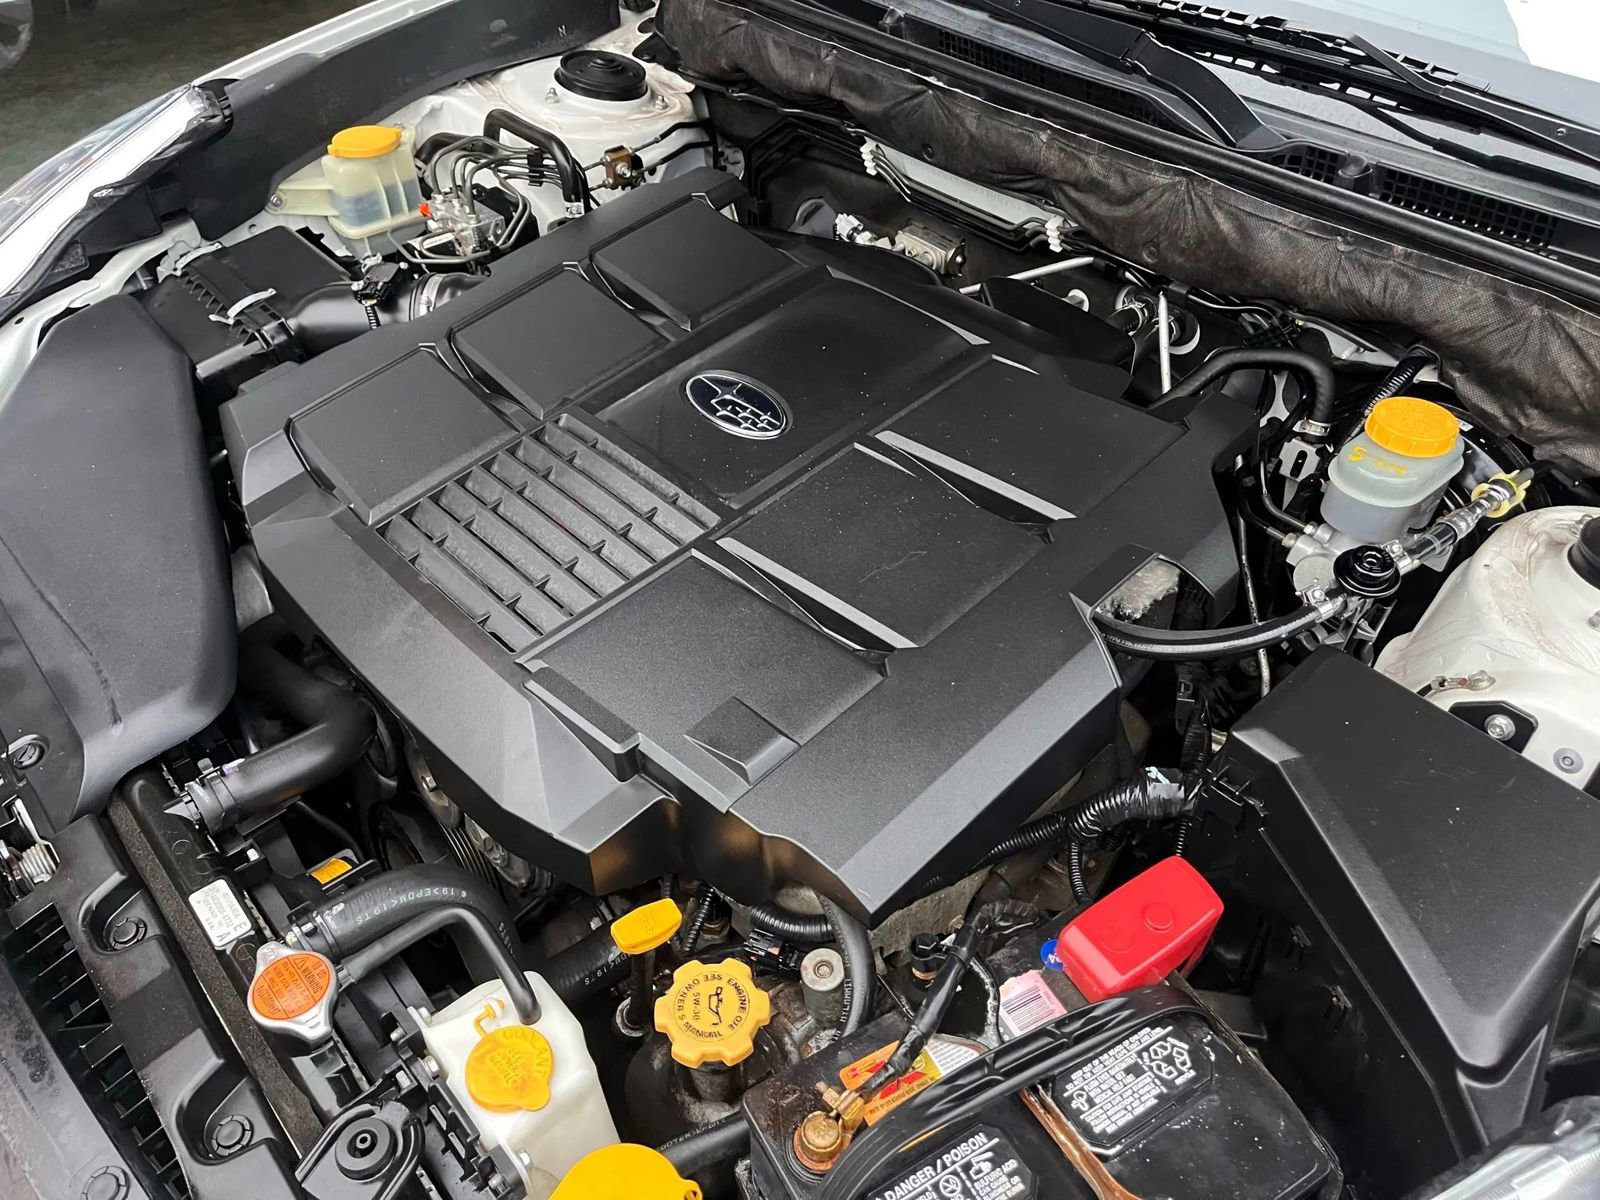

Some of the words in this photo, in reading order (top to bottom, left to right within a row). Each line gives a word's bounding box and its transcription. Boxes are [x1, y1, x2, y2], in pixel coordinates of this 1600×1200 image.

[299, 965, 323, 994] WARNING
[703, 973, 722, 981] SEE
[727, 978, 747, 1014] ENGINE
[728, 1015, 743, 1031] OIL
[1065, 1082, 1074, 1090] DO
[1072, 1076, 1084, 1085] NOT
[1103, 1055, 1116, 1066] VENT
[1114, 1047, 1128, 1059] CAPS
[1082, 1063, 1093, 1073] OUT
[1092, 1058, 1100, 1066] OF
[1098, 1052, 1109, 1062] THE
[1107, 1043, 1124, 1056] REACH
[1122, 1038, 1130, 1046] OF
[884, 1167, 936, 1200] DANGER
[942, 1132, 989, 1166] POISON
[974, 1168, 1003, 1190] SULFURIC
[1001, 1159, 1018, 1173] ACID
[1010, 1175, 1021, 1185] OR
[979, 1186, 991, 1196] CAN
[990, 1175, 1009, 1188] CAUSE
